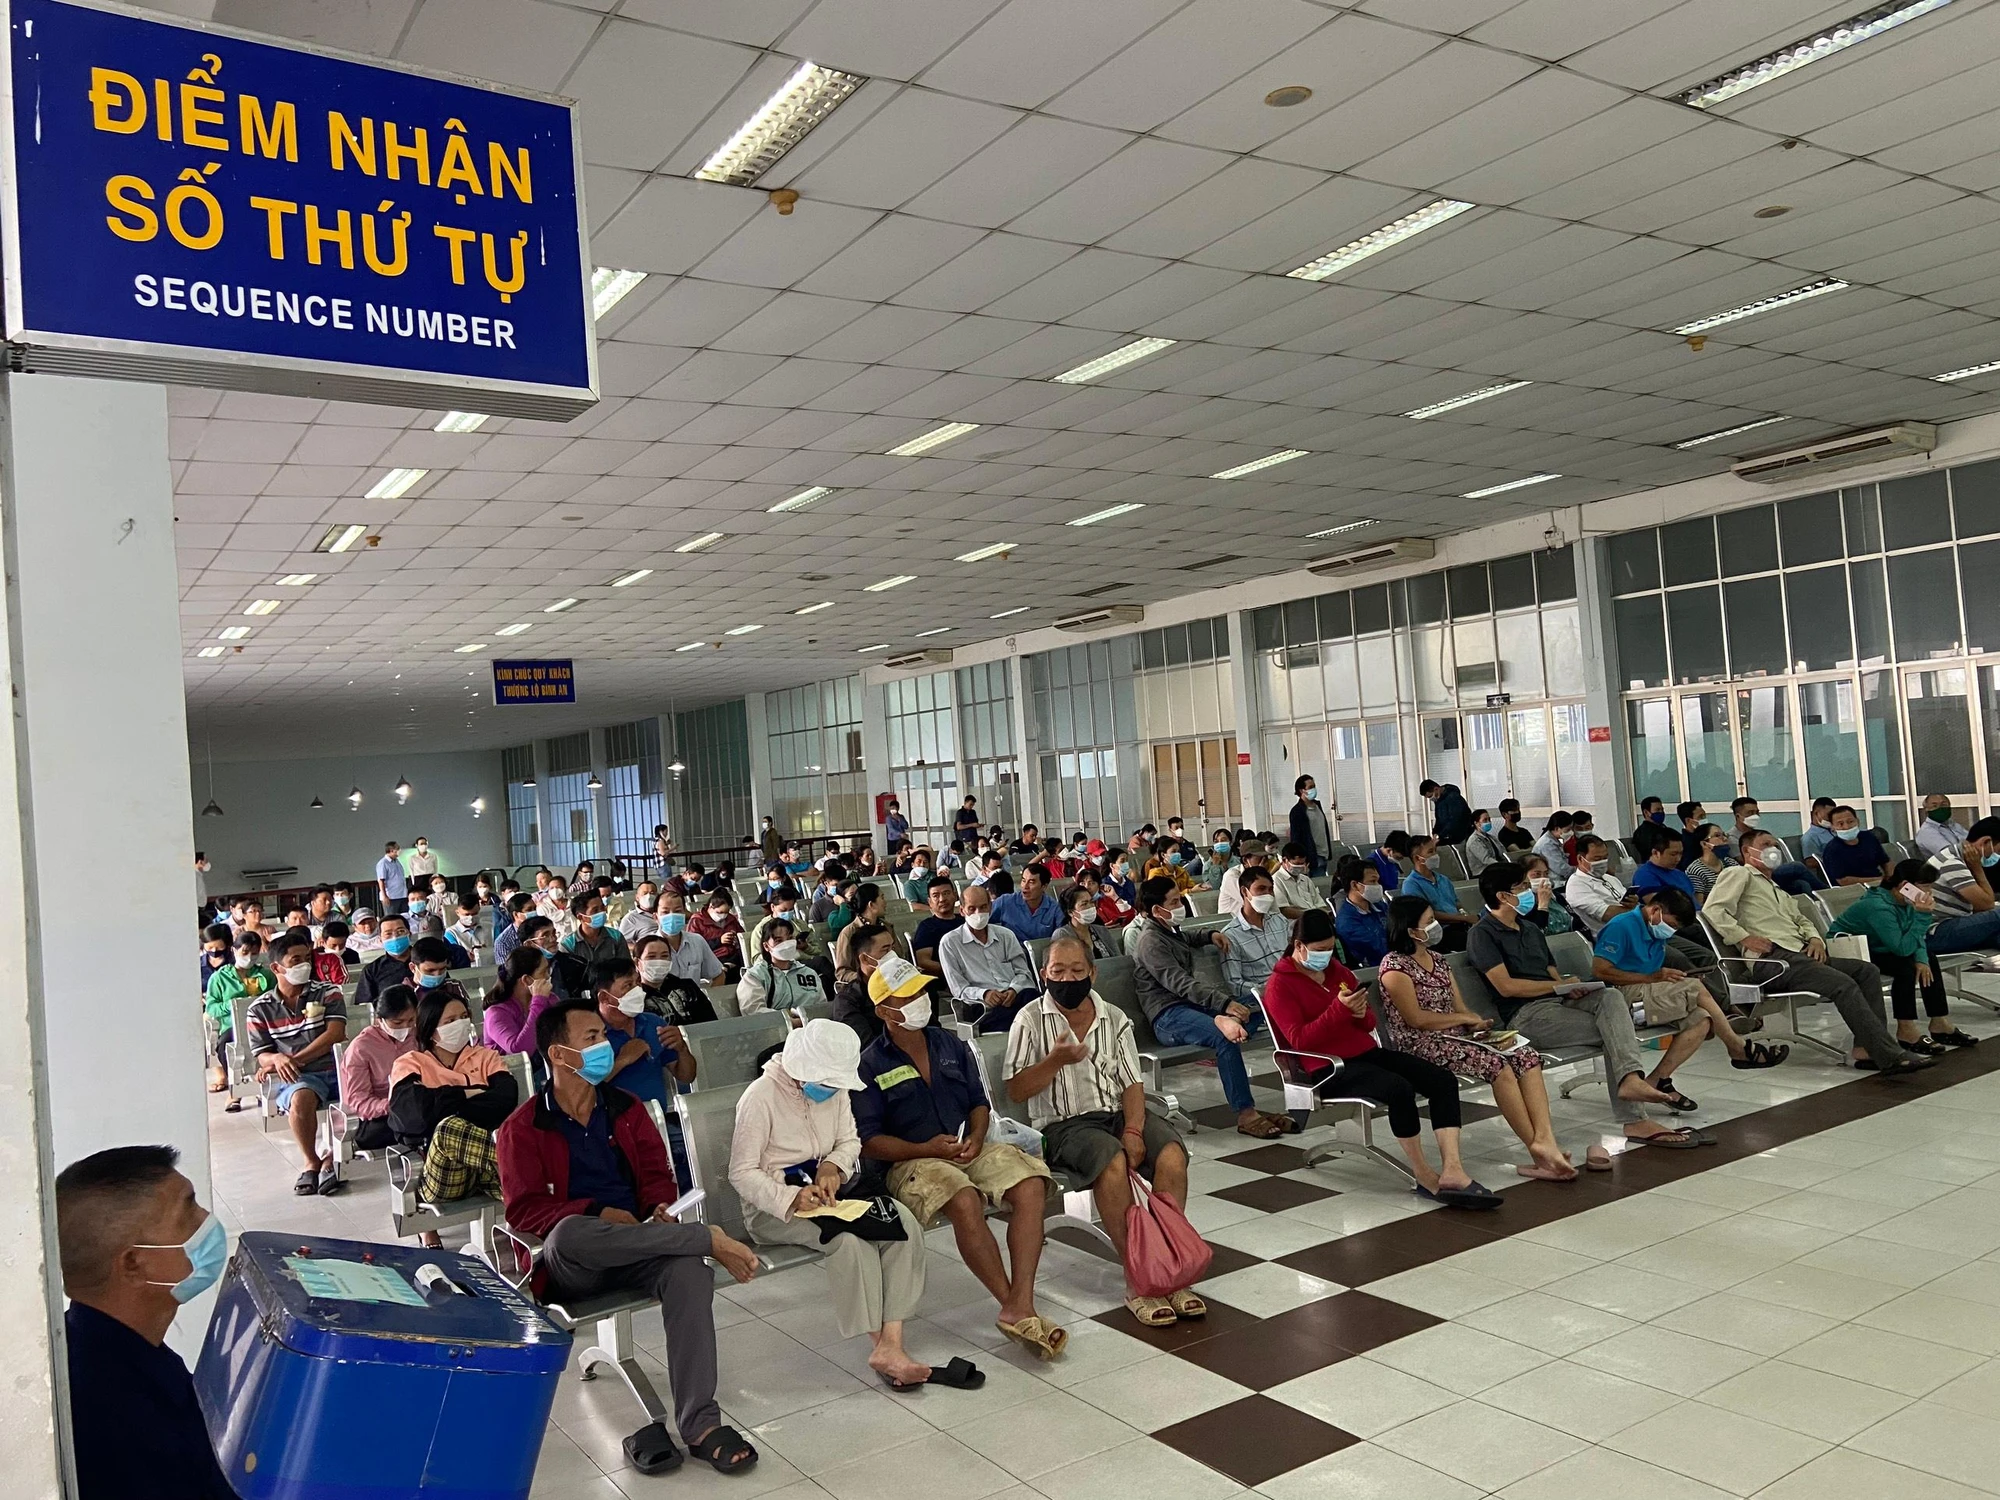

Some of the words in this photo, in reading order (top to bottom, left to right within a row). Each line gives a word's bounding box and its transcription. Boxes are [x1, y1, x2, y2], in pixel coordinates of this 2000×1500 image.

[89, 54, 298, 163] ĐIỂM
[328, 112, 532, 206] NHẬN
[106, 162, 224, 250] SỐ
[250, 196, 411, 277] THỨ
[434, 226, 528, 303] TỰ
[134, 274, 354, 330] SEQUENCE
[366, 303, 517, 350] NUMBER
